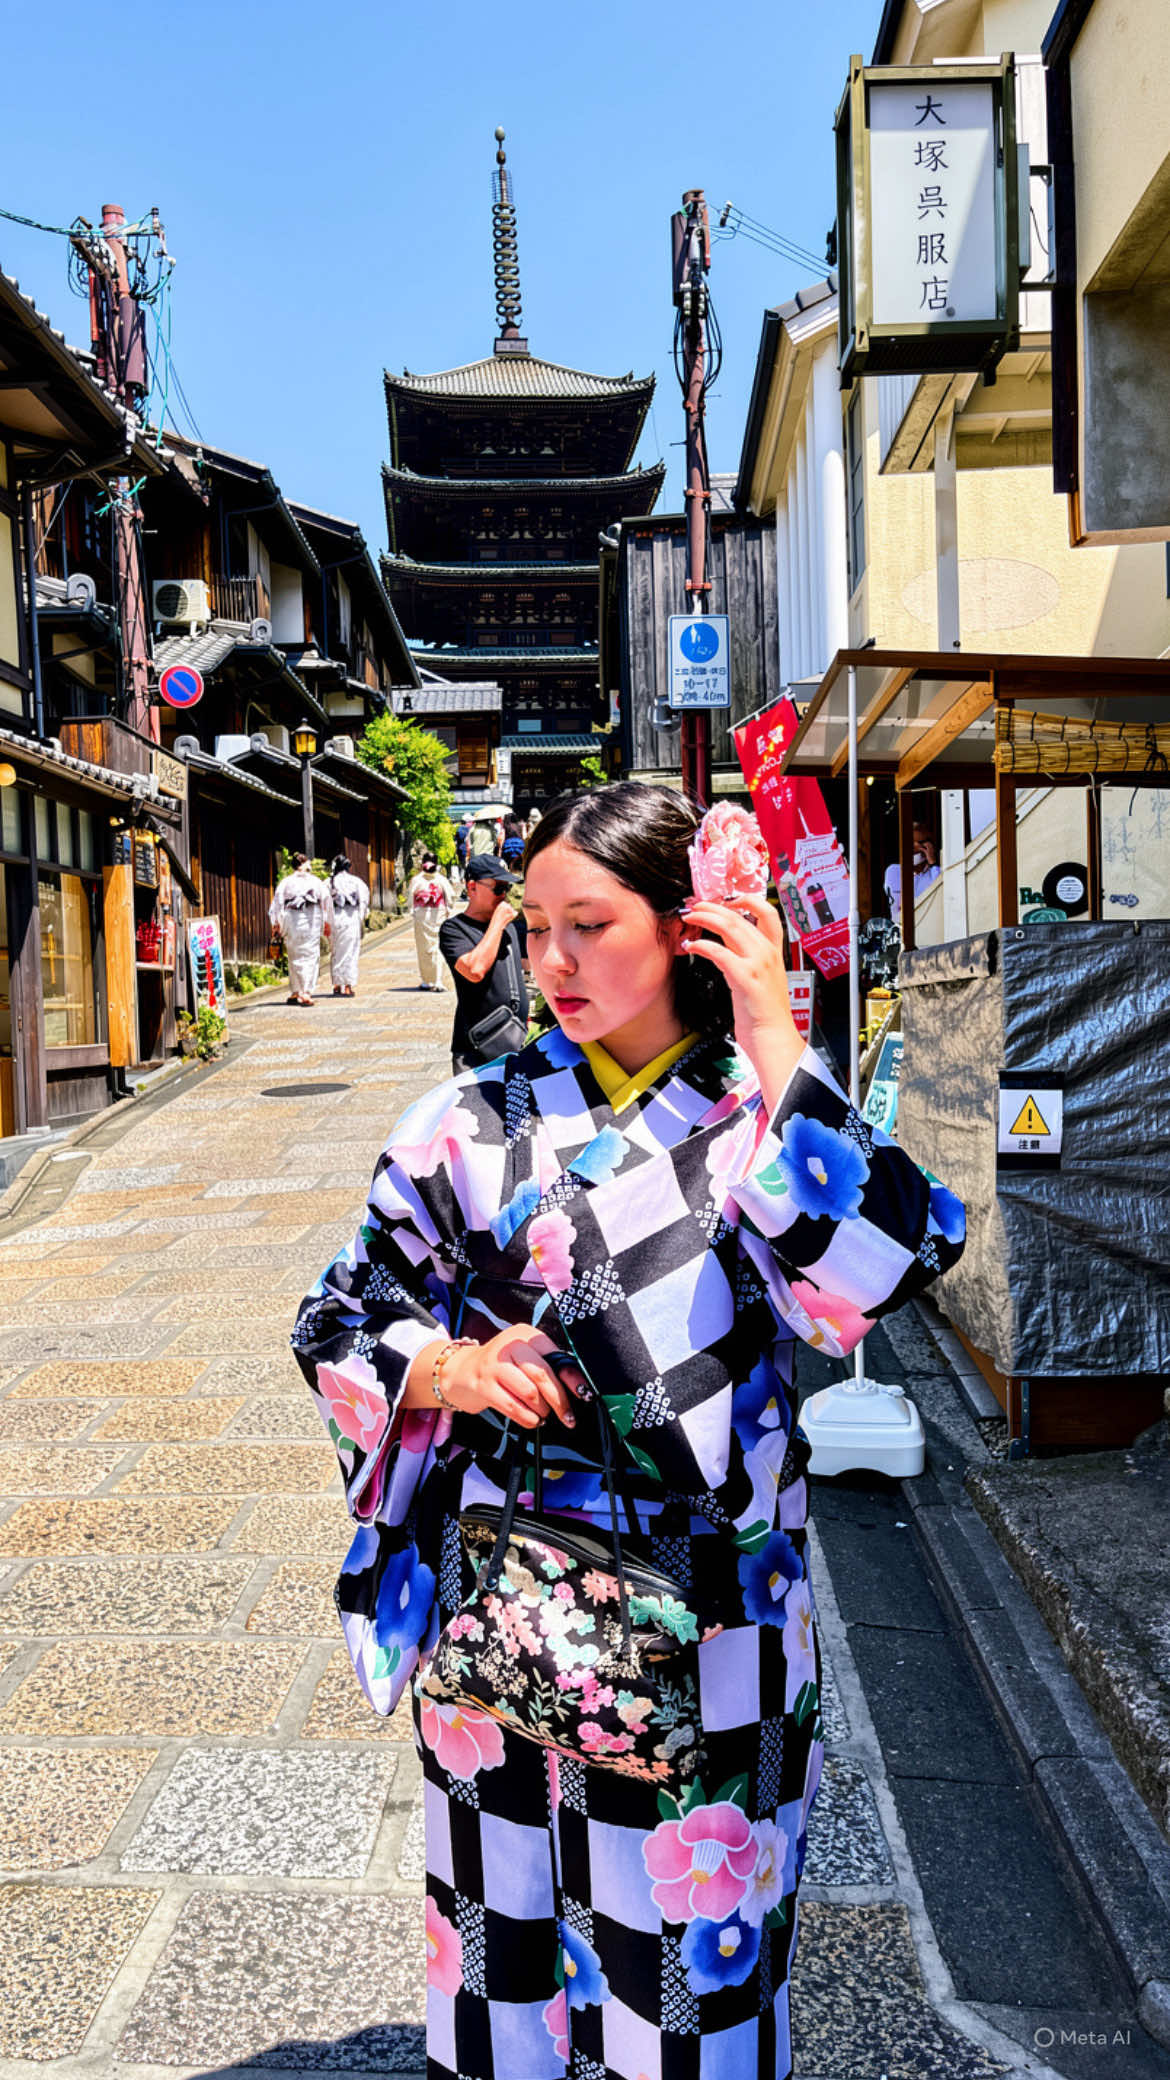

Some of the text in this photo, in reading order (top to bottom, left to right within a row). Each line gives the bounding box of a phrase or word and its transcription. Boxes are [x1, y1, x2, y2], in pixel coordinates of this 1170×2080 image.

[914, 95, 949, 312] 大塚呉服店
